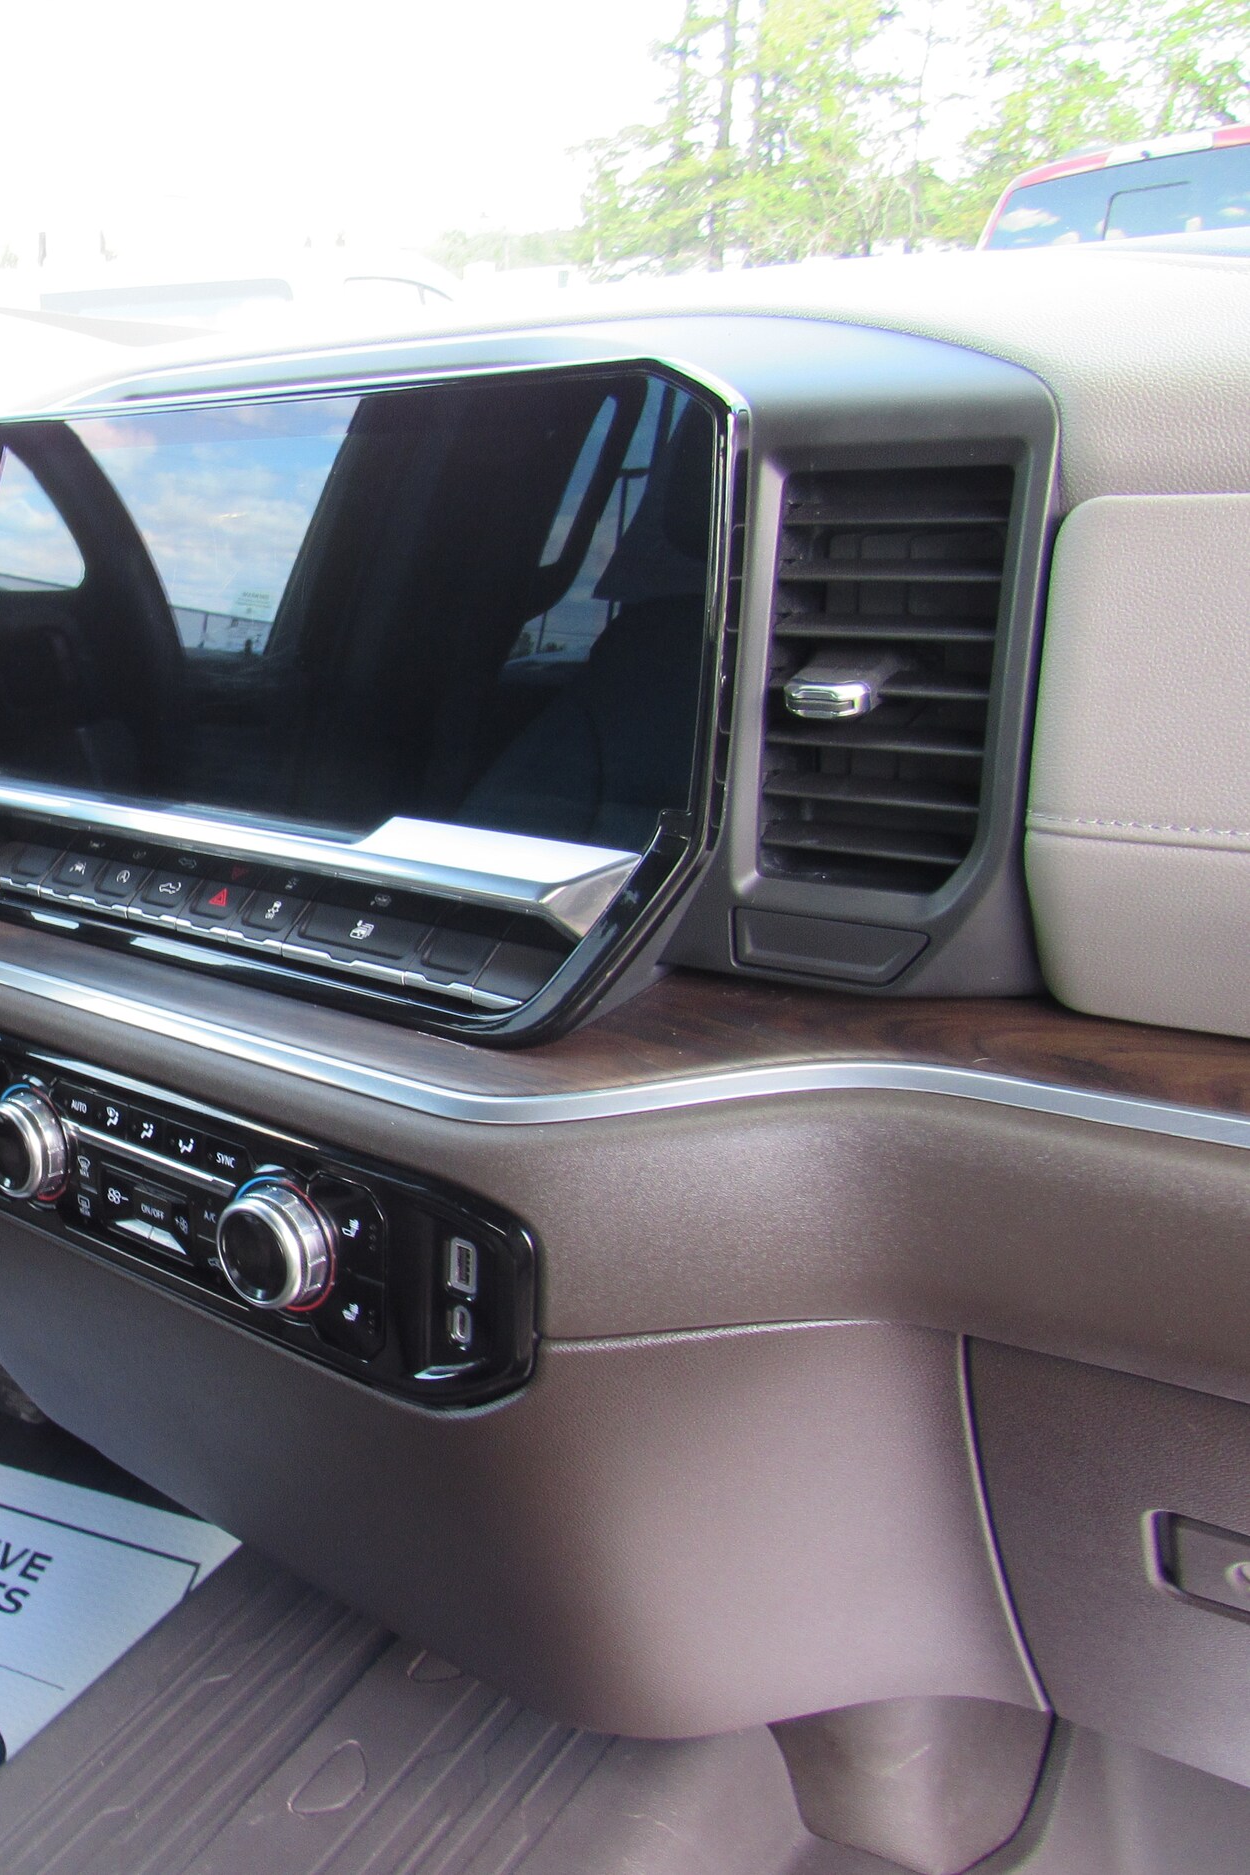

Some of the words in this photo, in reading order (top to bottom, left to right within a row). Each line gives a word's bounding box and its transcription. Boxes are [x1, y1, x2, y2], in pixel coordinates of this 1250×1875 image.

[71, 1099, 87, 1114] AUTO
[215, 1152, 236, 1168] SYNC
[140, 1202, 165, 1220] ON/OFF
[203, 1210, 216, 1224] A/C
